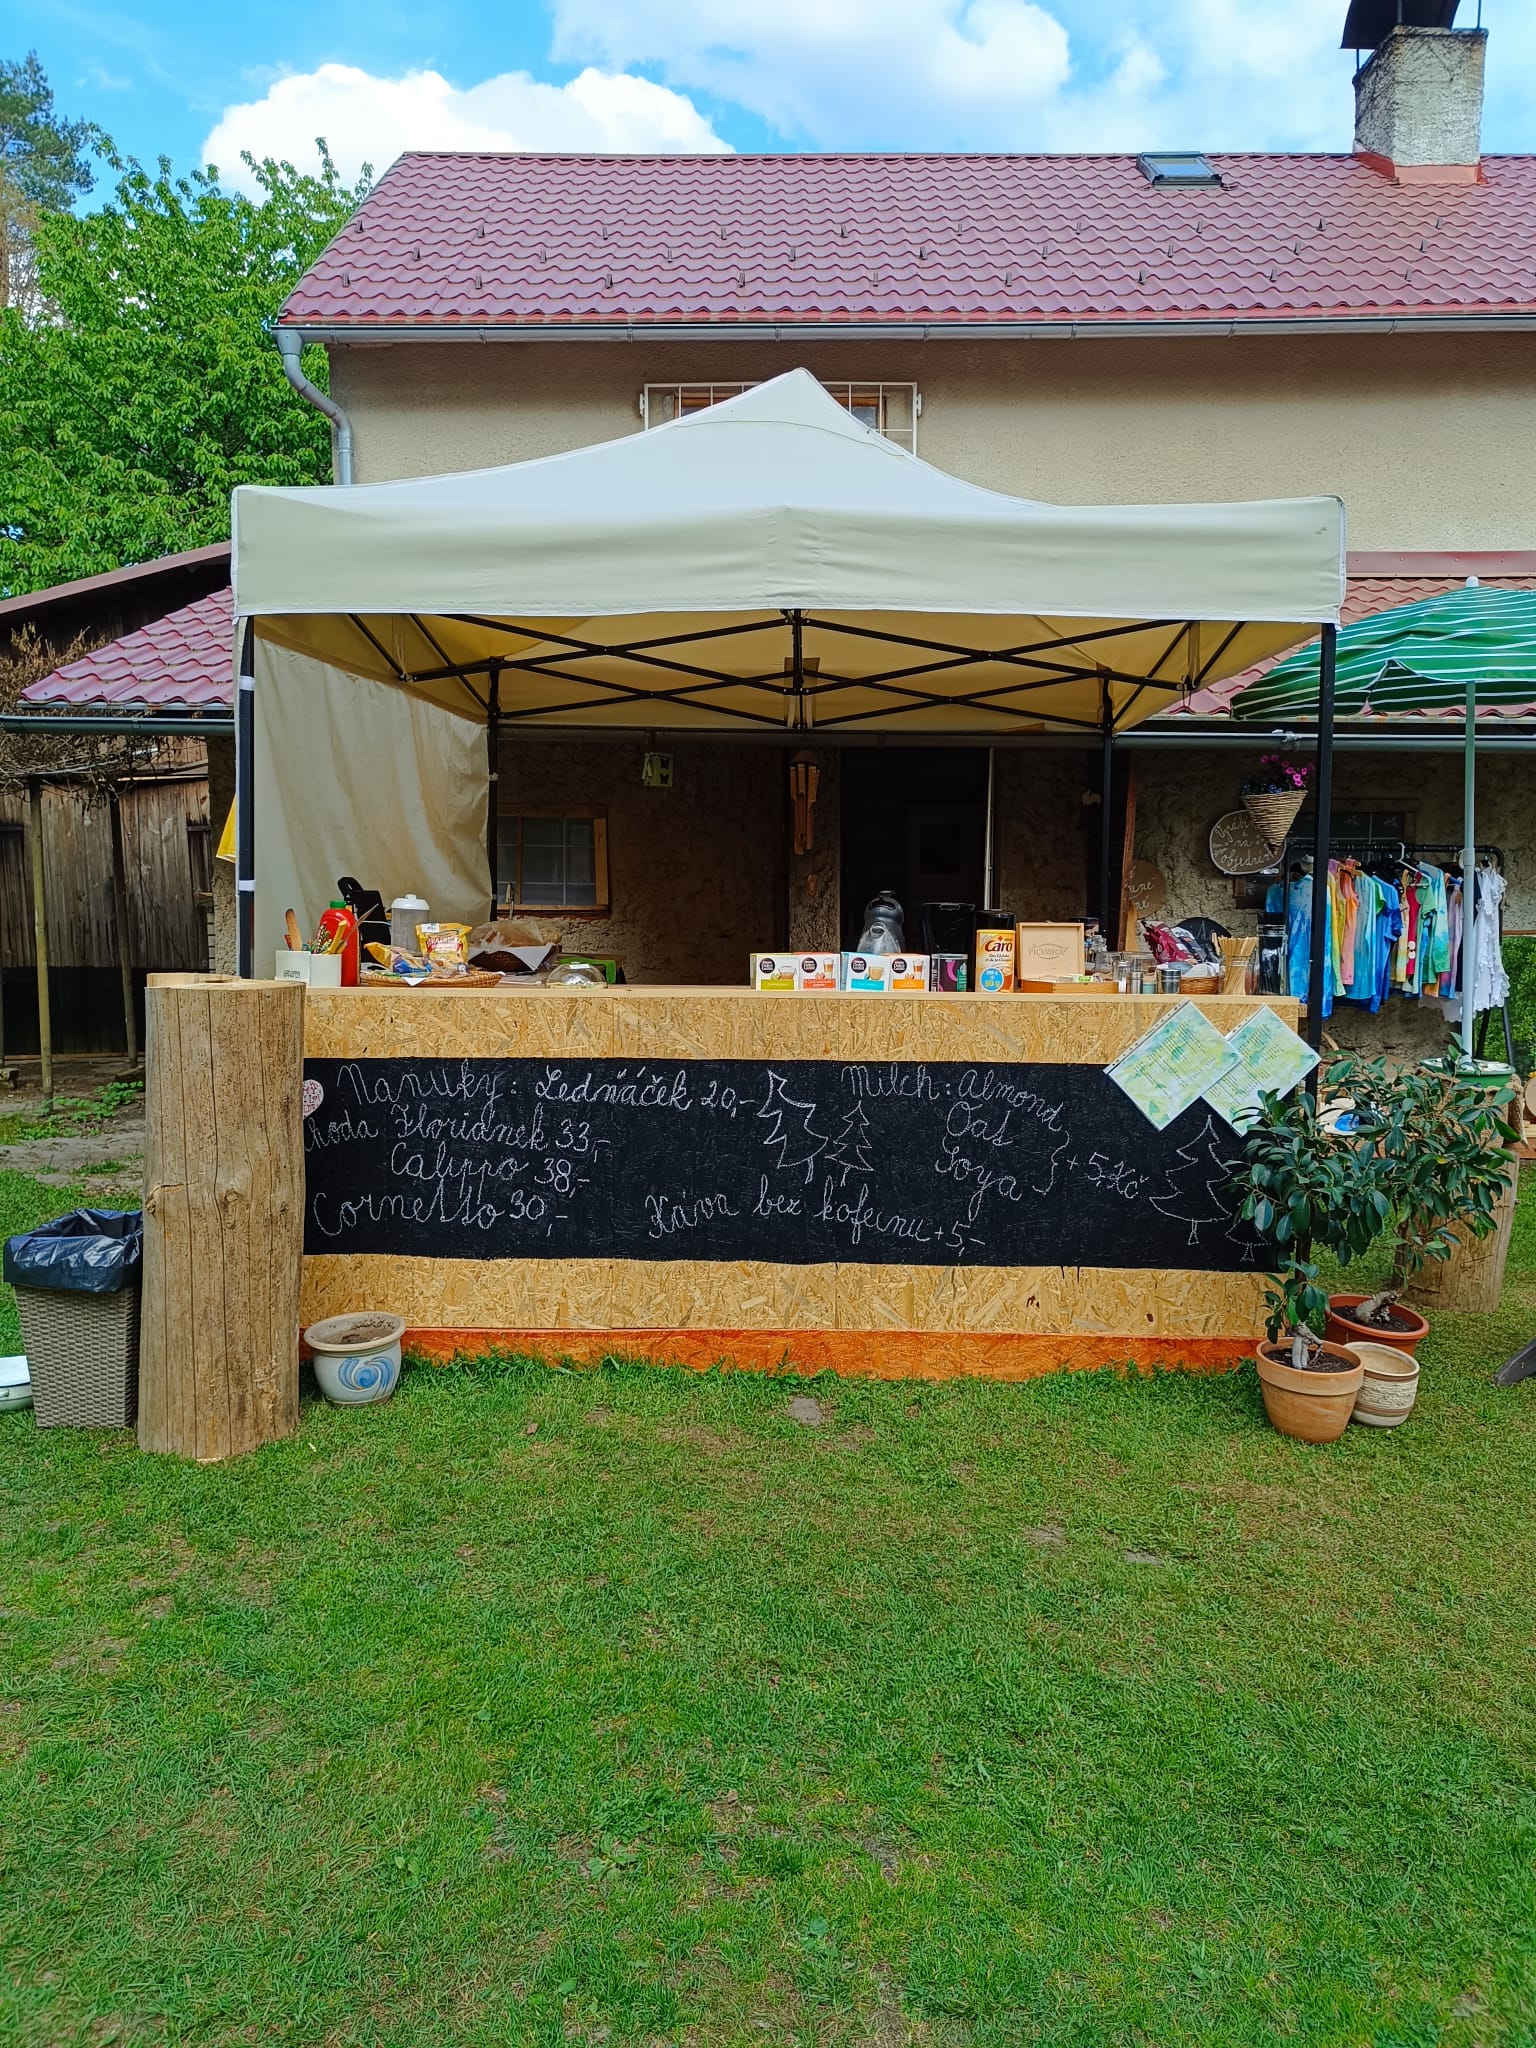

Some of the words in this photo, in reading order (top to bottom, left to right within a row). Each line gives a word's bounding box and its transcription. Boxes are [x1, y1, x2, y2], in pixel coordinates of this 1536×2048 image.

[984, 940, 1013, 953] Caro
[957, 1068, 1065, 1132] Almond
[313, 1179, 505, 1237] Cornetto
[752, 1174, 802, 1216] bez
[935, 1138, 1022, 1222] Soya
